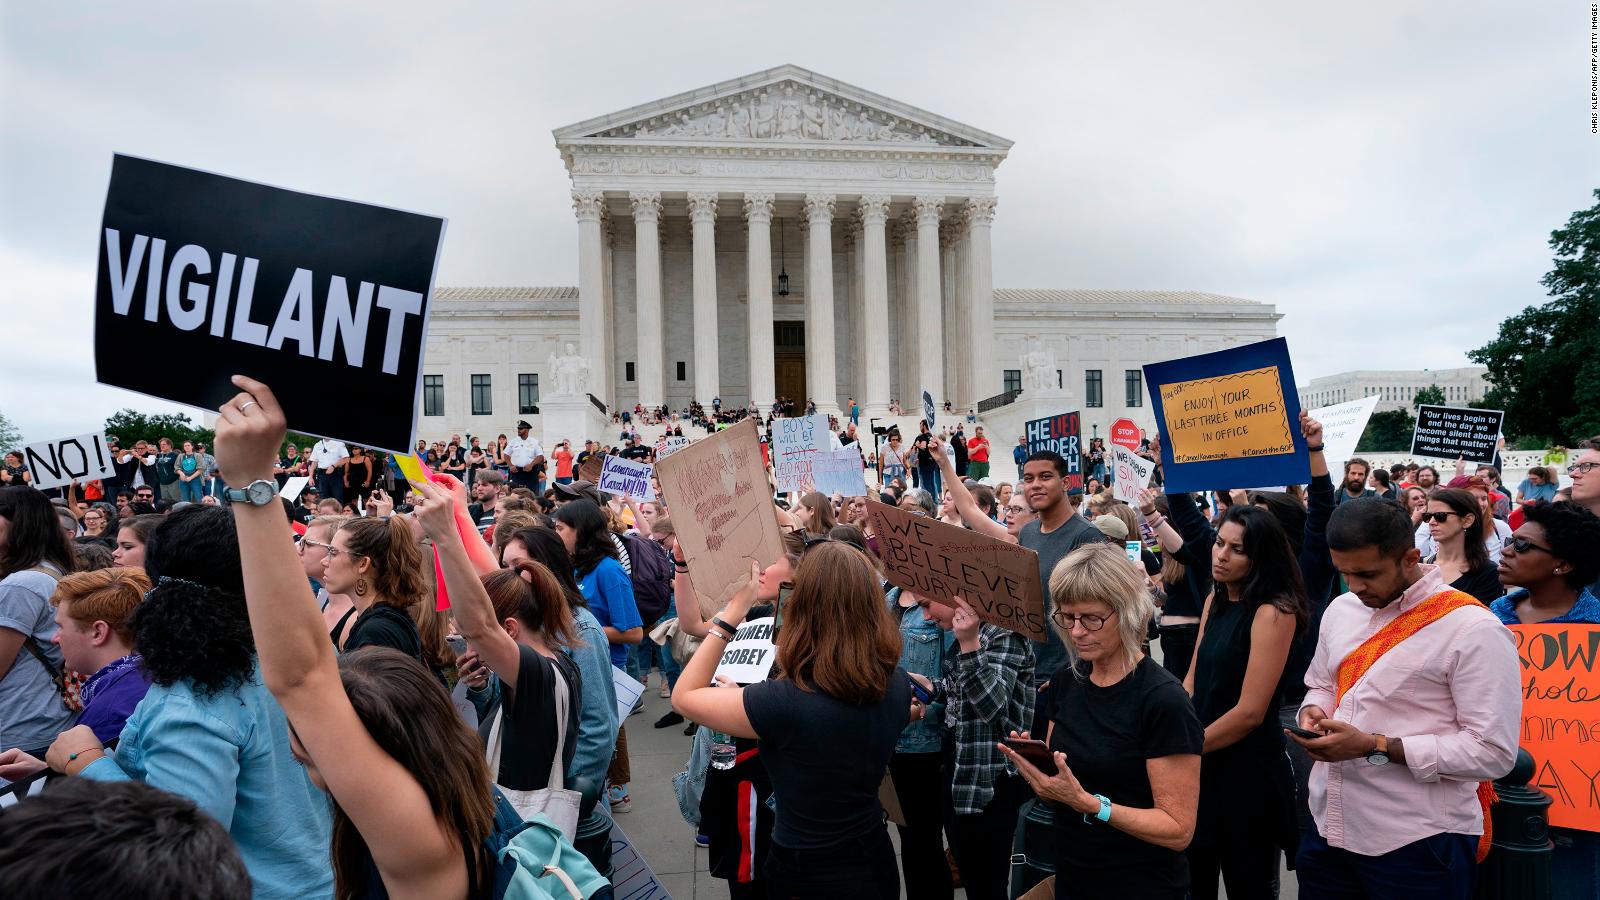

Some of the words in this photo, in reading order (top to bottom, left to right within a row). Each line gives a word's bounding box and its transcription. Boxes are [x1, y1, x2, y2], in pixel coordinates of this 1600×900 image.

[105, 227, 423, 375] VIGILANT
[1184, 396, 1214, 411] ENJOY
[1221, 389, 1251, 405] YOUR
[783, 415, 813, 433] BOYS
[1174, 417, 1199, 430] LAST
[1199, 412, 1228, 426] THREE
[1234, 402, 1277, 419] MONTHS
[1460, 422, 1474, 431] day
[1464, 414, 1485, 423] begin
[1028, 420, 1050, 442] HE
[1051, 415, 1078, 438] LIED
[1203, 432, 1212, 442] IN
[1215, 426, 1249, 440] OFFICE
[1417, 427, 1446, 435] become
[1449, 430, 1471, 438] silent
[1417, 435, 1440, 444] things
[1029, 436, 1078, 455] UNDER
[25, 435, 106, 484] NO!
[603, 456, 651, 479] Kavanaugh?
[880, 511, 933, 546] WE
[889, 538, 1023, 601] BELIEVE
[897, 566, 1044, 633] SURVIVORS
[721, 649, 767, 665] SOBEY
[1521, 676, 1600, 702] hole
